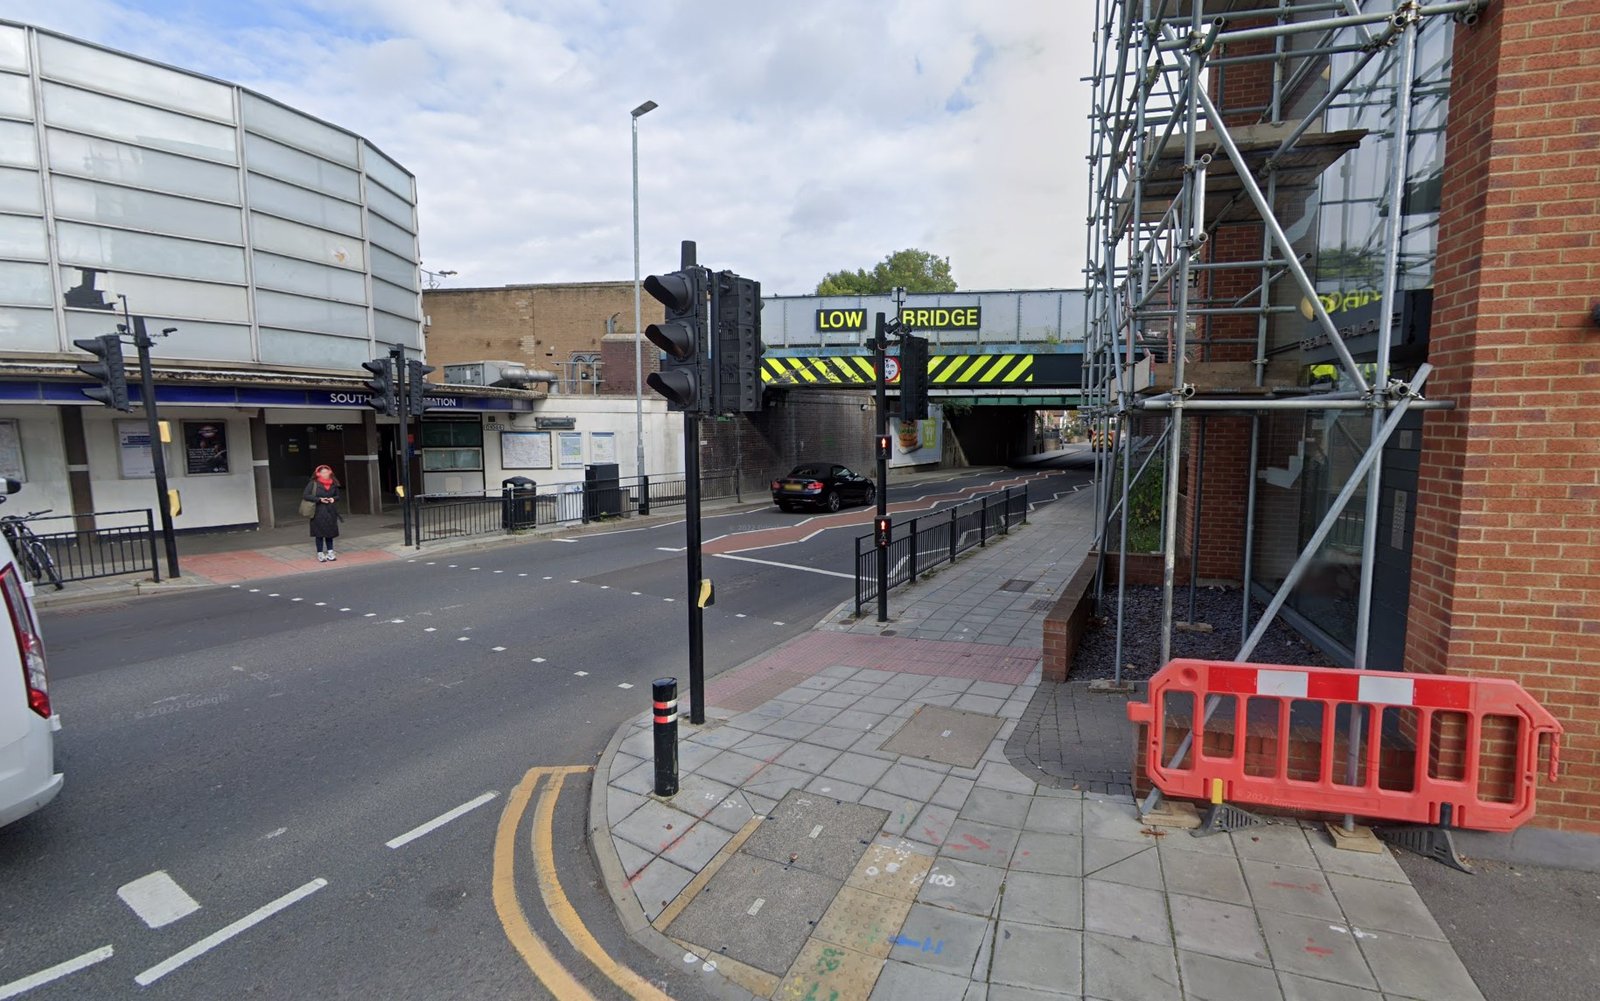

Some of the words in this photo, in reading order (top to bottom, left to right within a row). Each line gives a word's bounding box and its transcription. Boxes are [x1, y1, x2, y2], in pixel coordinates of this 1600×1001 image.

[820, 311, 863, 328] LOW
[902, 309, 978, 327] BRIDGE
[330, 393, 372, 403] SOUTH
